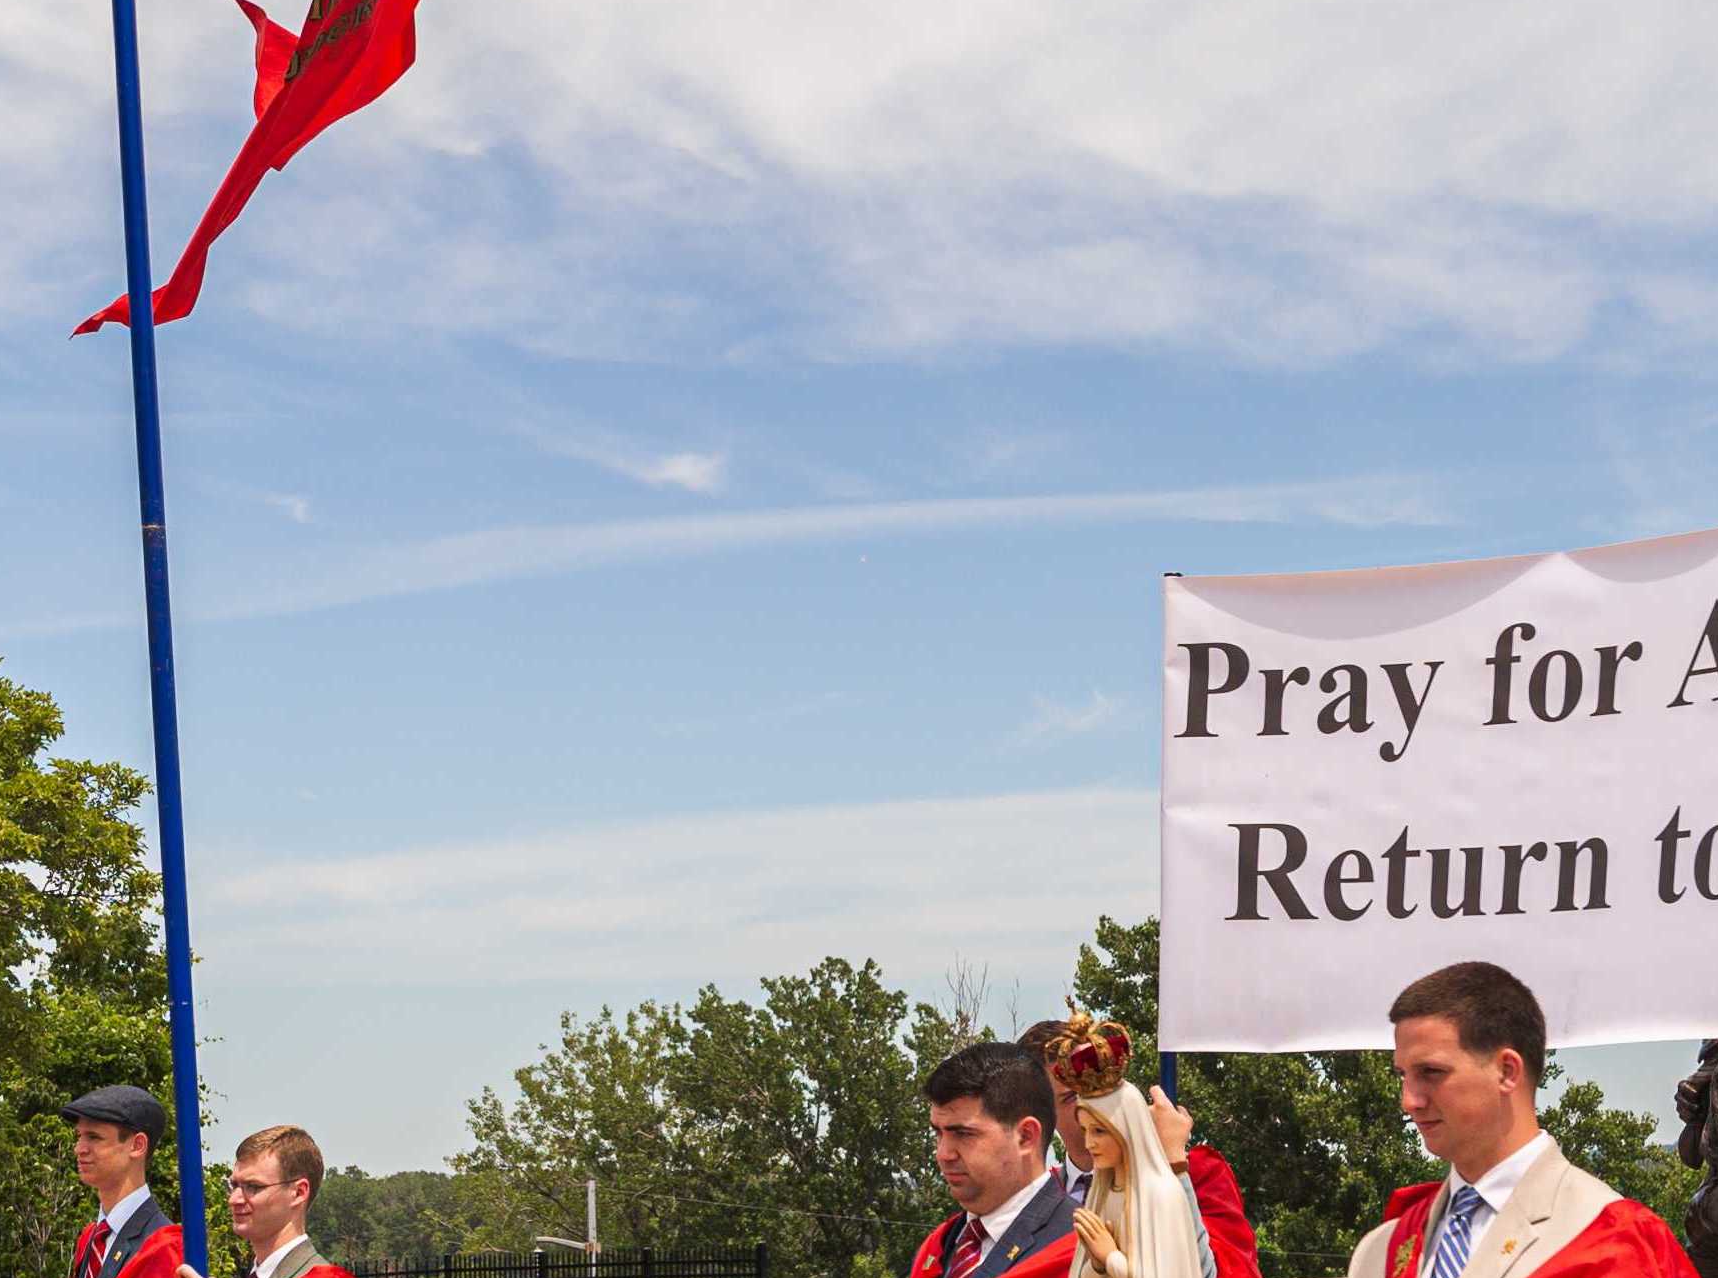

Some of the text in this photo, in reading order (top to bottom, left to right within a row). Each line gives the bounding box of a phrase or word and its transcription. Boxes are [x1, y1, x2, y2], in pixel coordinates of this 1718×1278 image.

[1173, 642, 1445, 763] Pray
[1482, 622, 1643, 726] for
[1224, 823, 1612, 922] Return
